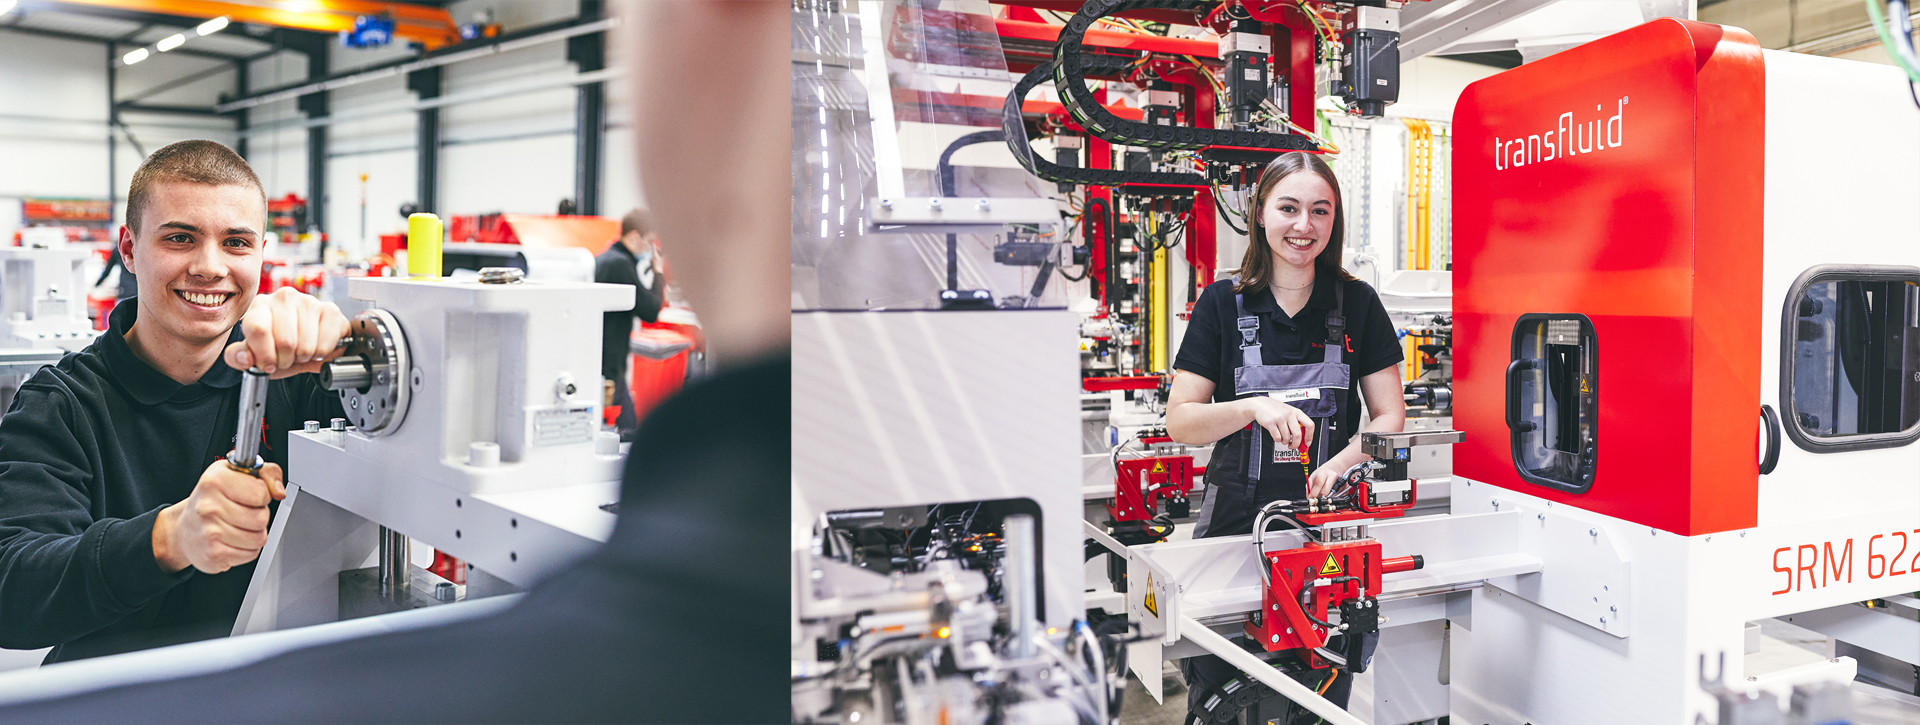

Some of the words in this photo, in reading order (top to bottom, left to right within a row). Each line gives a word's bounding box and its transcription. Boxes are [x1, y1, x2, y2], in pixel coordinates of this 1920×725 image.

[1495, 98, 1623, 171] transfluid
[1274, 449, 1300, 457] transflu
[1772, 538, 1853, 596] SRM
